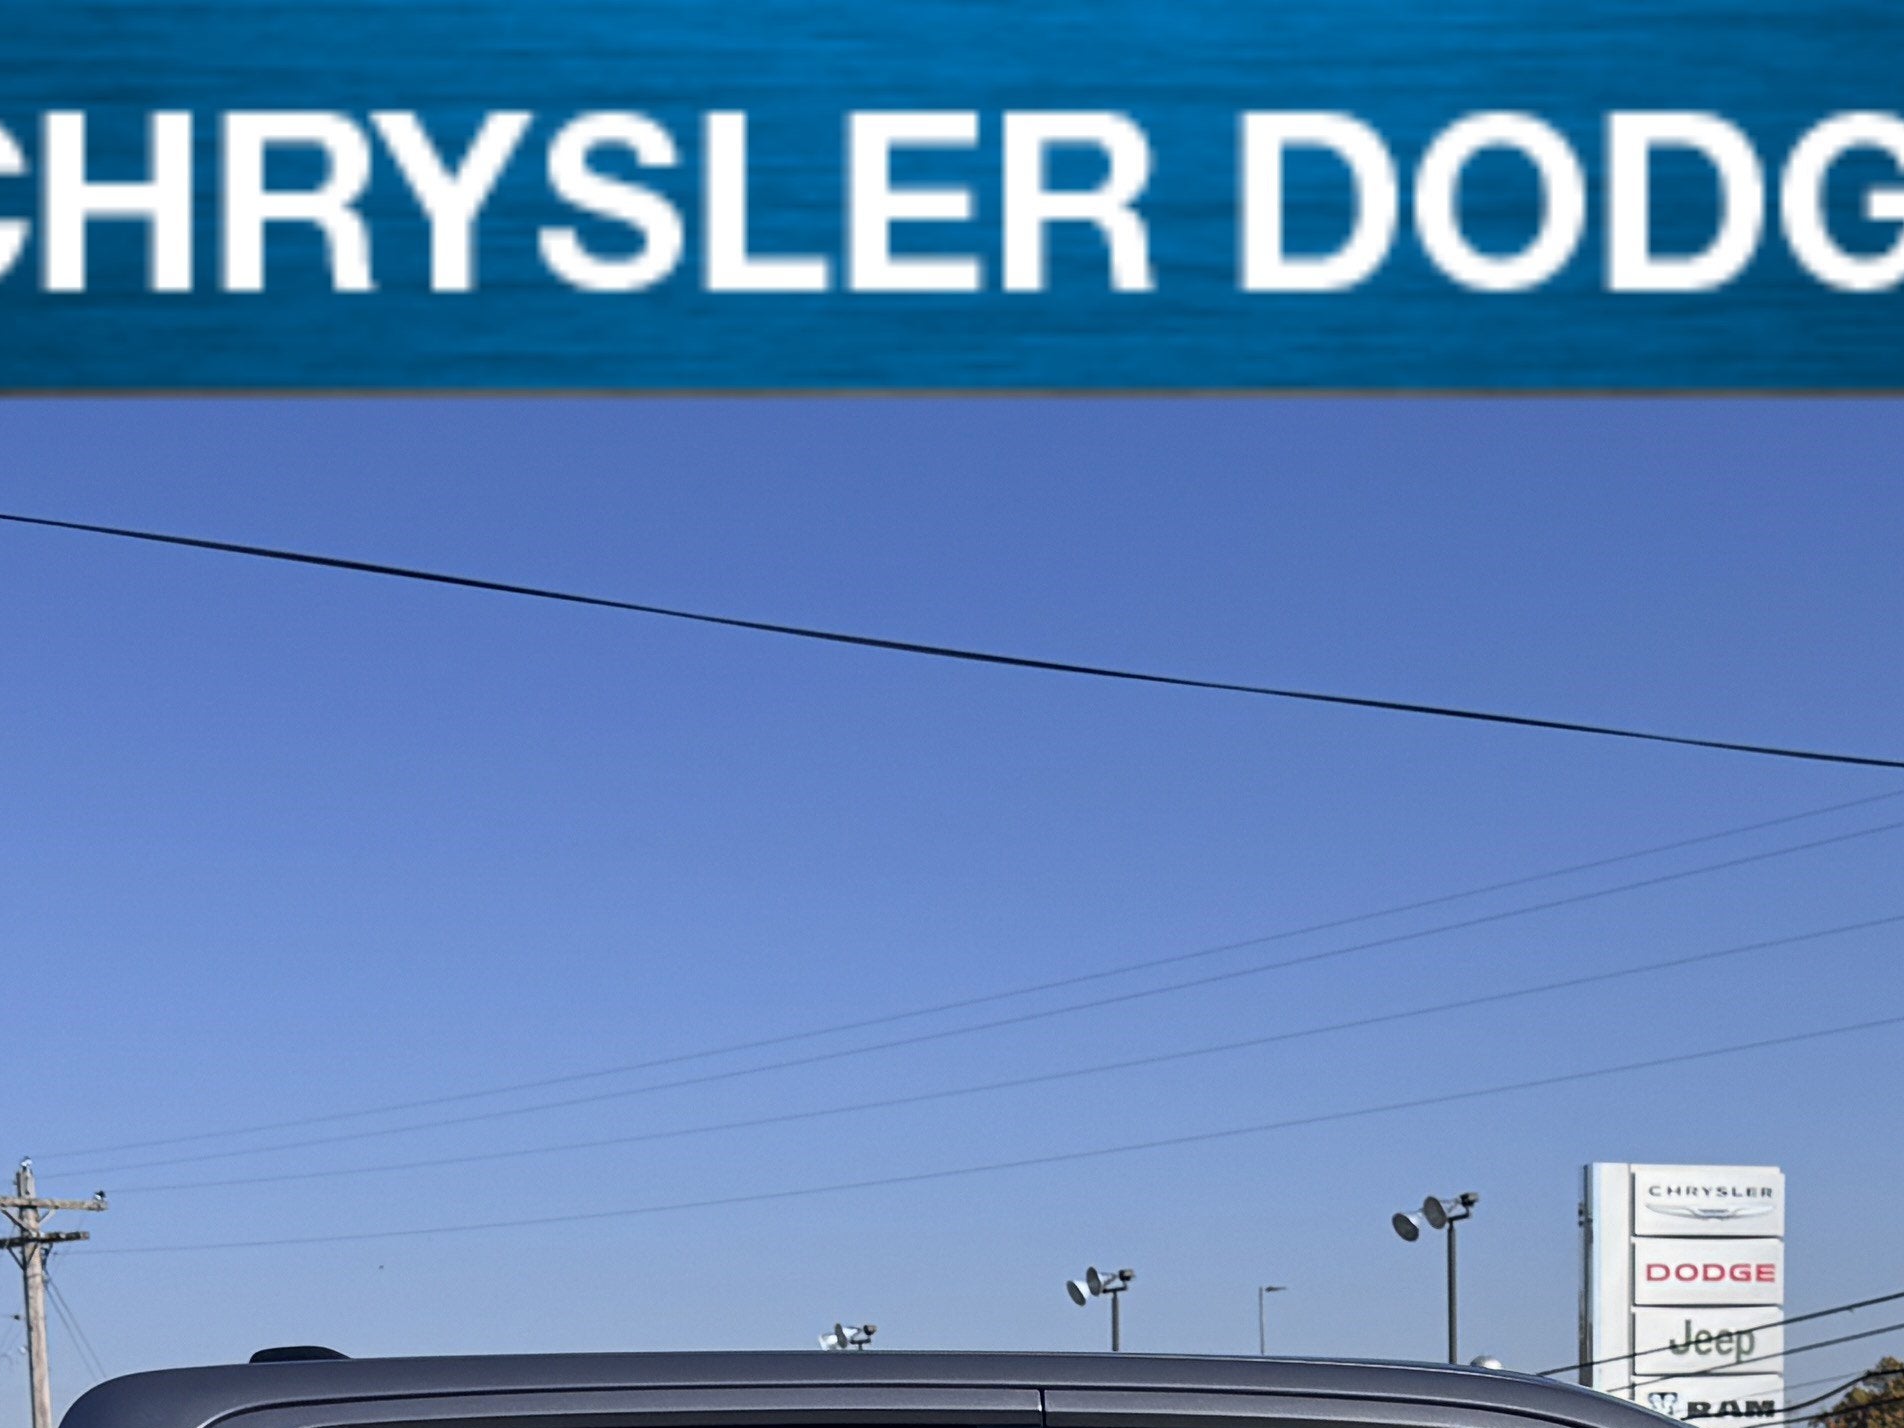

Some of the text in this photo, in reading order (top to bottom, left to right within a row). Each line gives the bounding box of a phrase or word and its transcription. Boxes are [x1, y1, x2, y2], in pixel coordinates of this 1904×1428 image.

[1648, 1184, 1773, 1199] CHRYSLER
[1646, 1262, 1776, 1283] DODGE
[1669, 1318, 1756, 1364] Jeep
[1686, 1399, 1776, 1419] RAM
